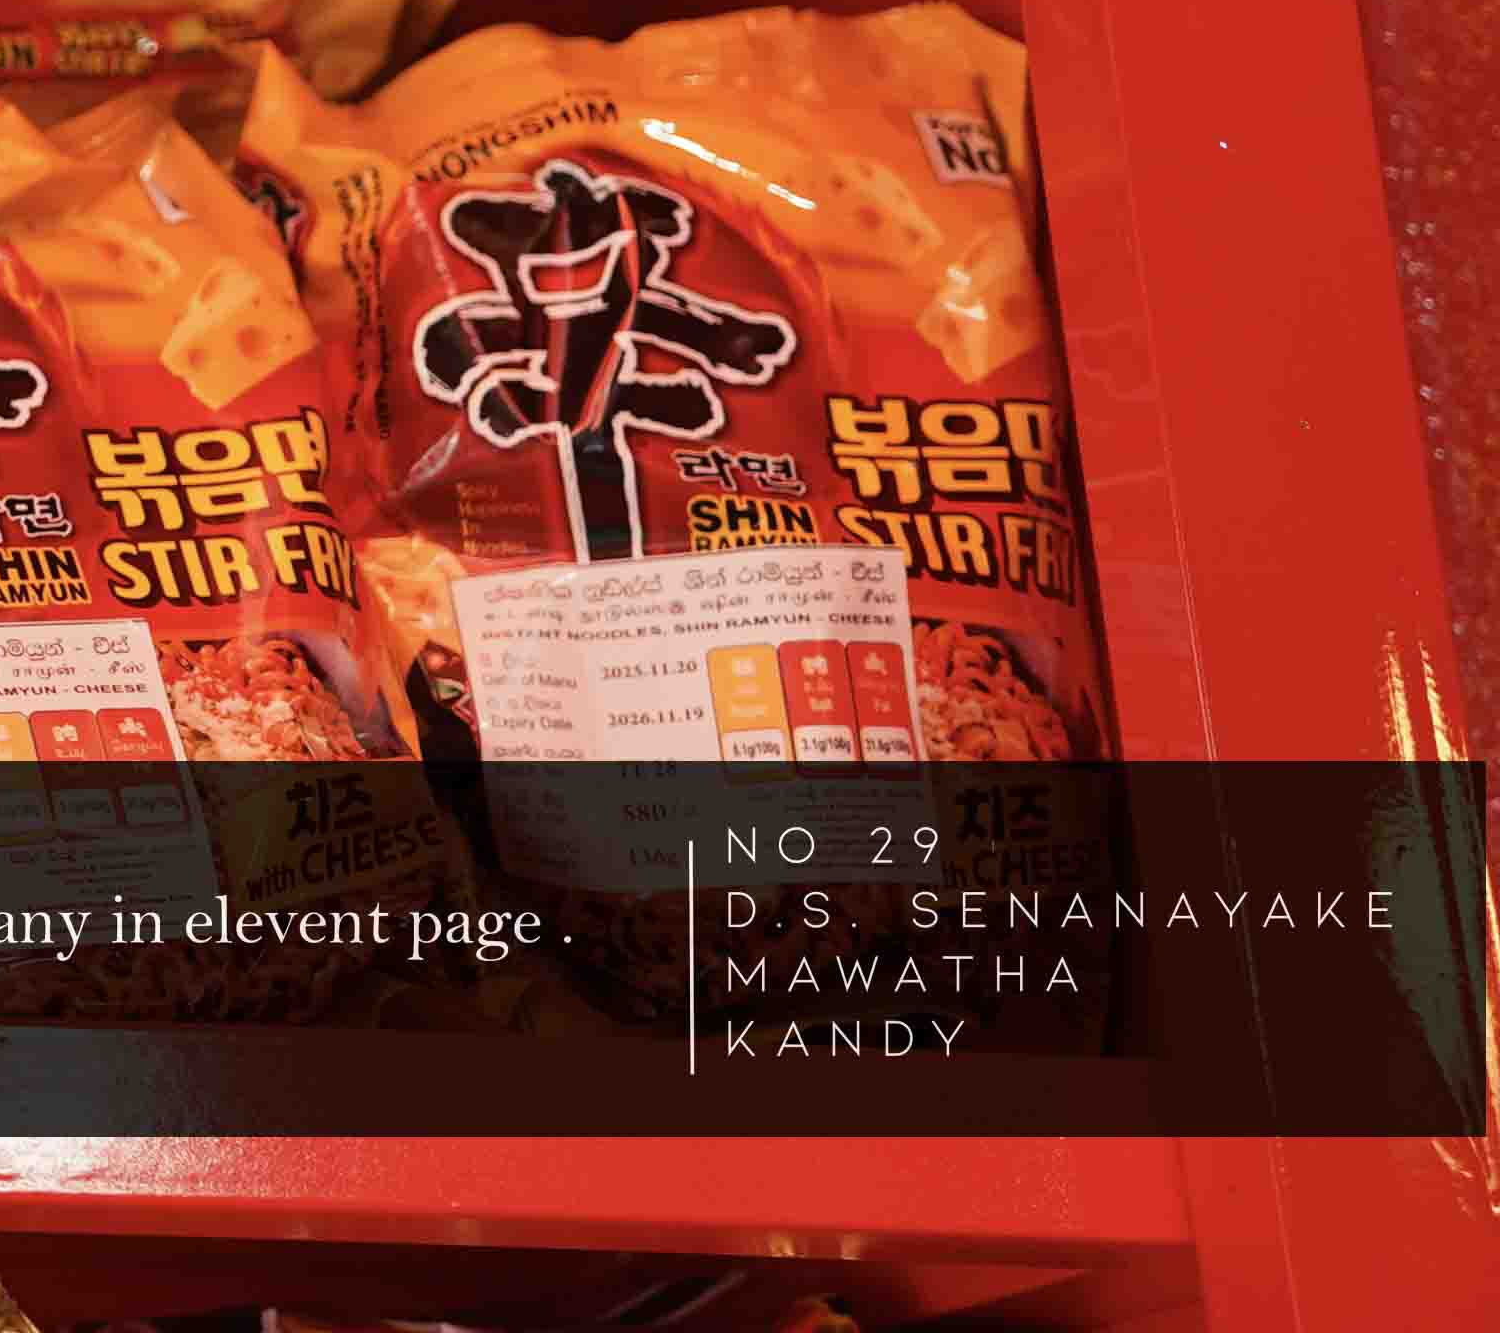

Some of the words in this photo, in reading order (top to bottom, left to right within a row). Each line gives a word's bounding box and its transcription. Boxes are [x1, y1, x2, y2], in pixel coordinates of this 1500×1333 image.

[86, 406, 332, 536] 볶음면
[673, 447, 807, 495] 라면
[687, 496, 817, 534] SHIN
[101, 535, 255, 608] STIR
[836, 509, 988, 585] STIR
[73, 681, 150, 695] CHEESE
